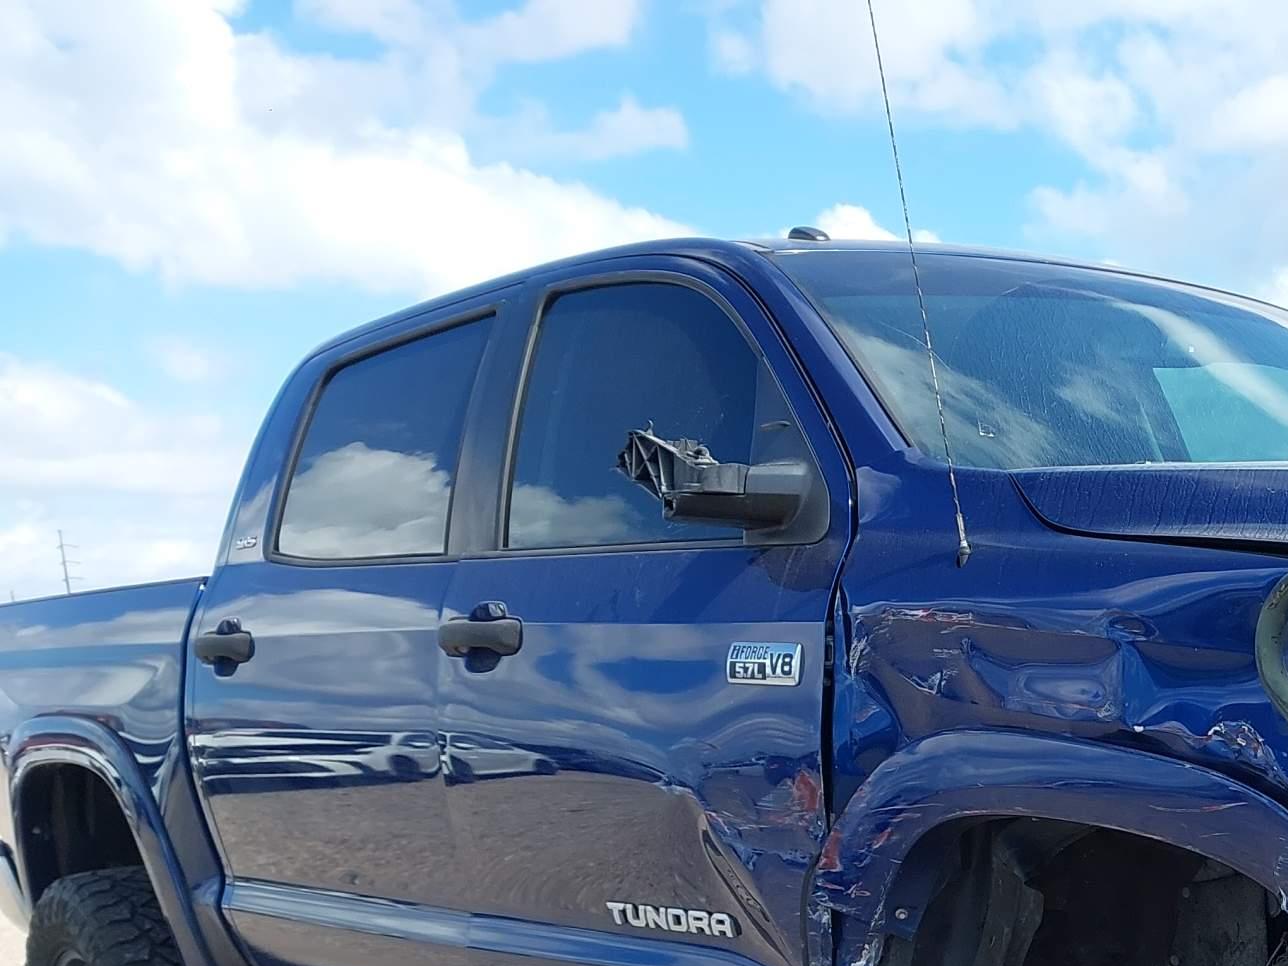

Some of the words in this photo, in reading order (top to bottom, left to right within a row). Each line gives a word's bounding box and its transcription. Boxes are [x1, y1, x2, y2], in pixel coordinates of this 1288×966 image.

[735, 662, 763, 678] 5.7L
[769, 653, 794, 676] V8
[606, 901, 736, 938] TUNDRA
